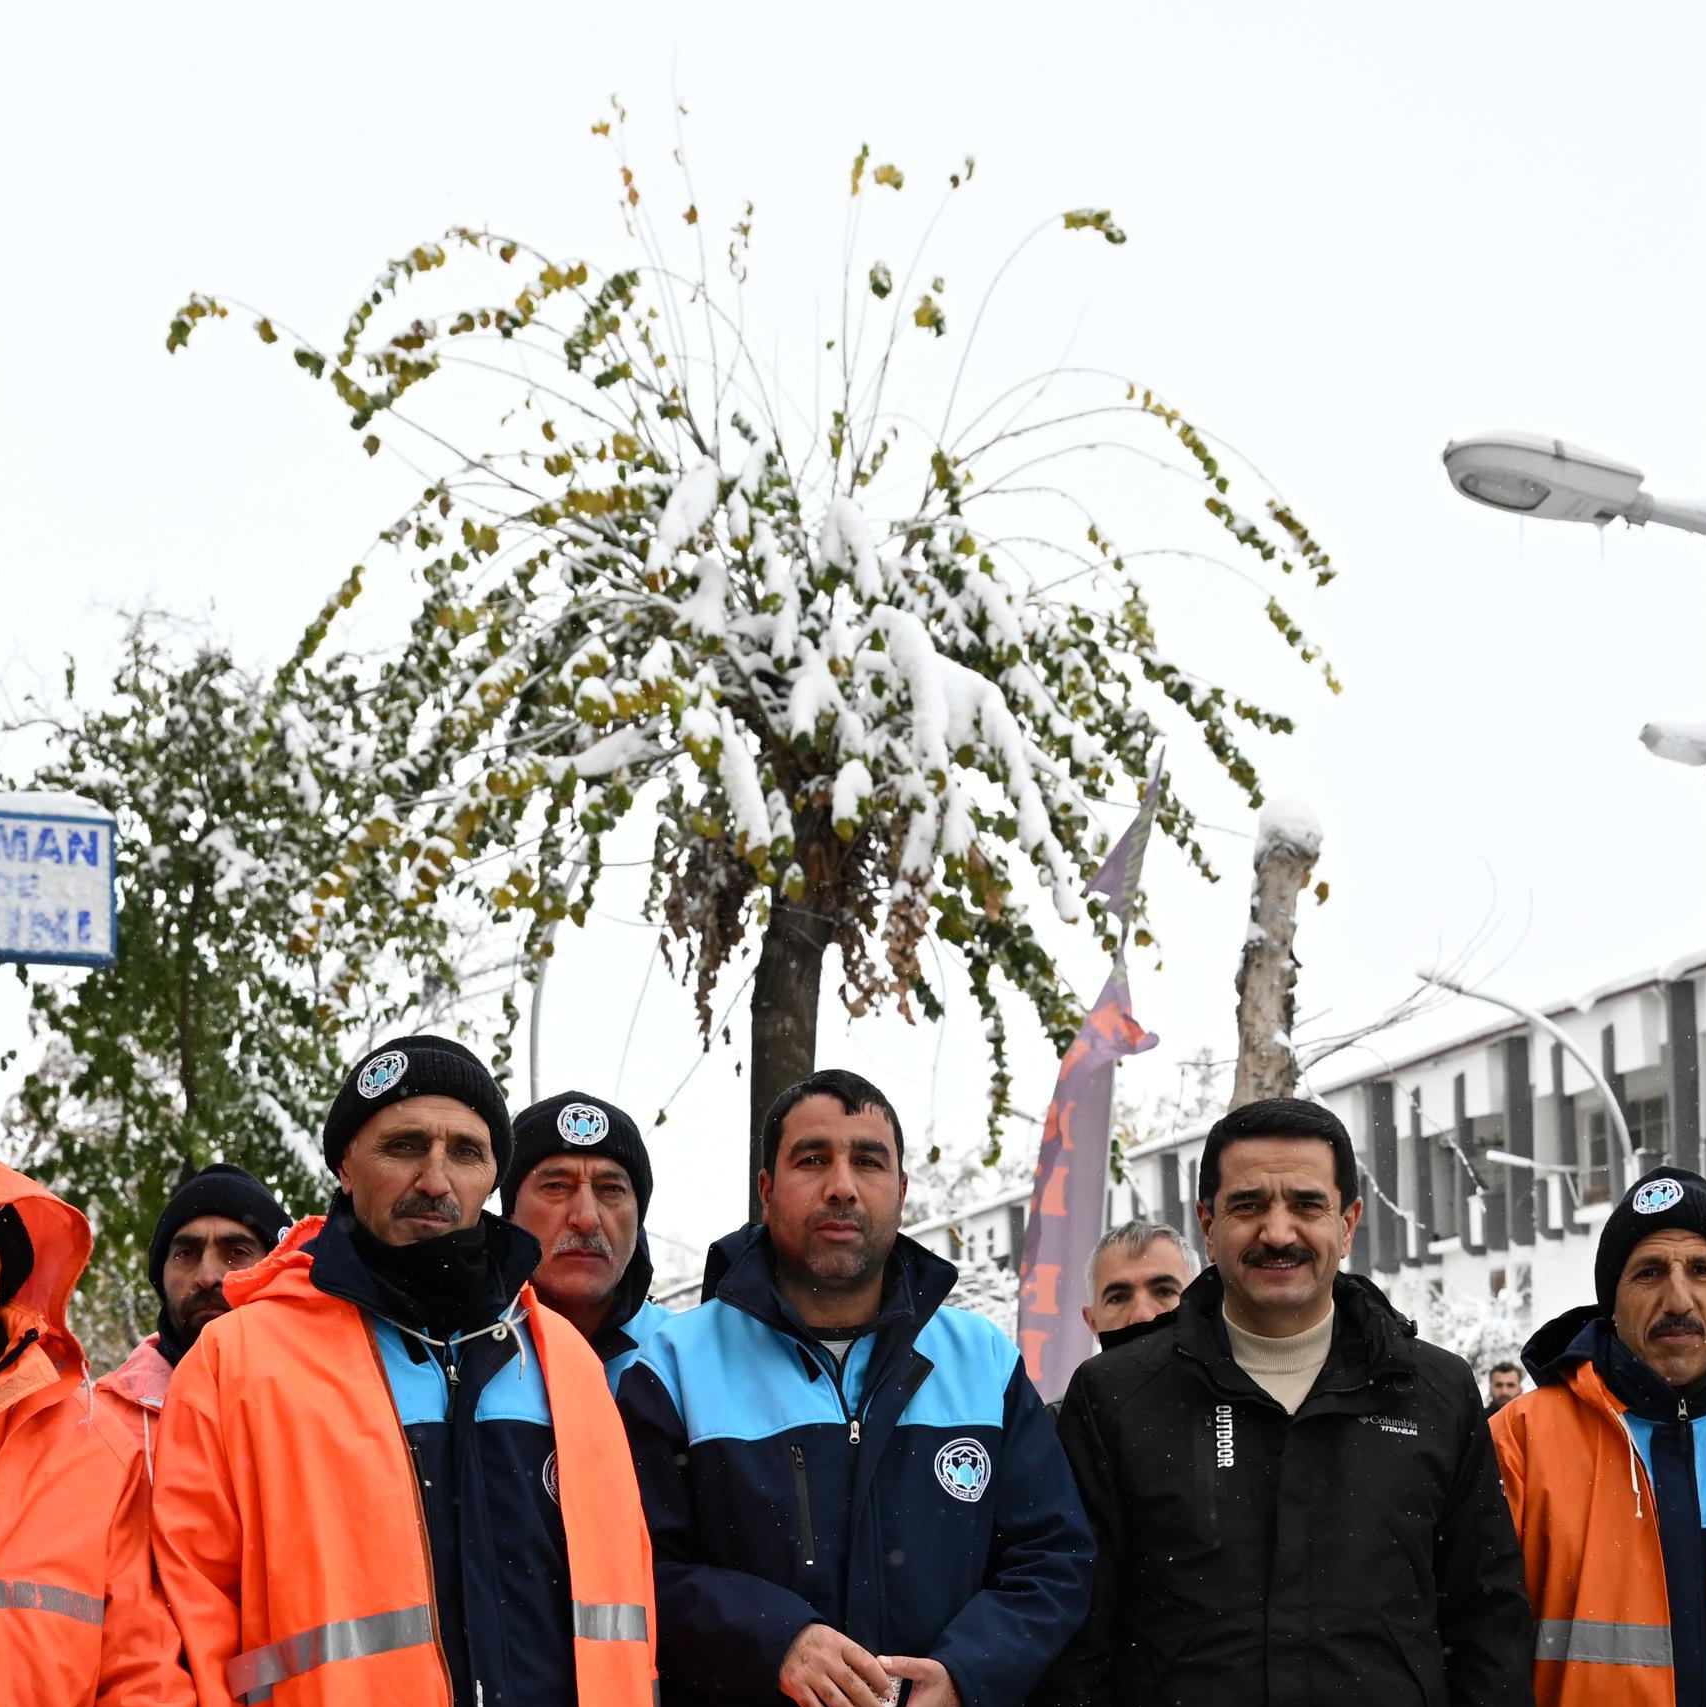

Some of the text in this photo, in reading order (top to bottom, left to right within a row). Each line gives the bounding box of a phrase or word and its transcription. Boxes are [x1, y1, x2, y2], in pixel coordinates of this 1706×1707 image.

[1369, 1415, 1418, 1429] Columbia
[1215, 1404, 1235, 1469] OUTDOOR
[1380, 1425, 1418, 1437] TITANIUM
